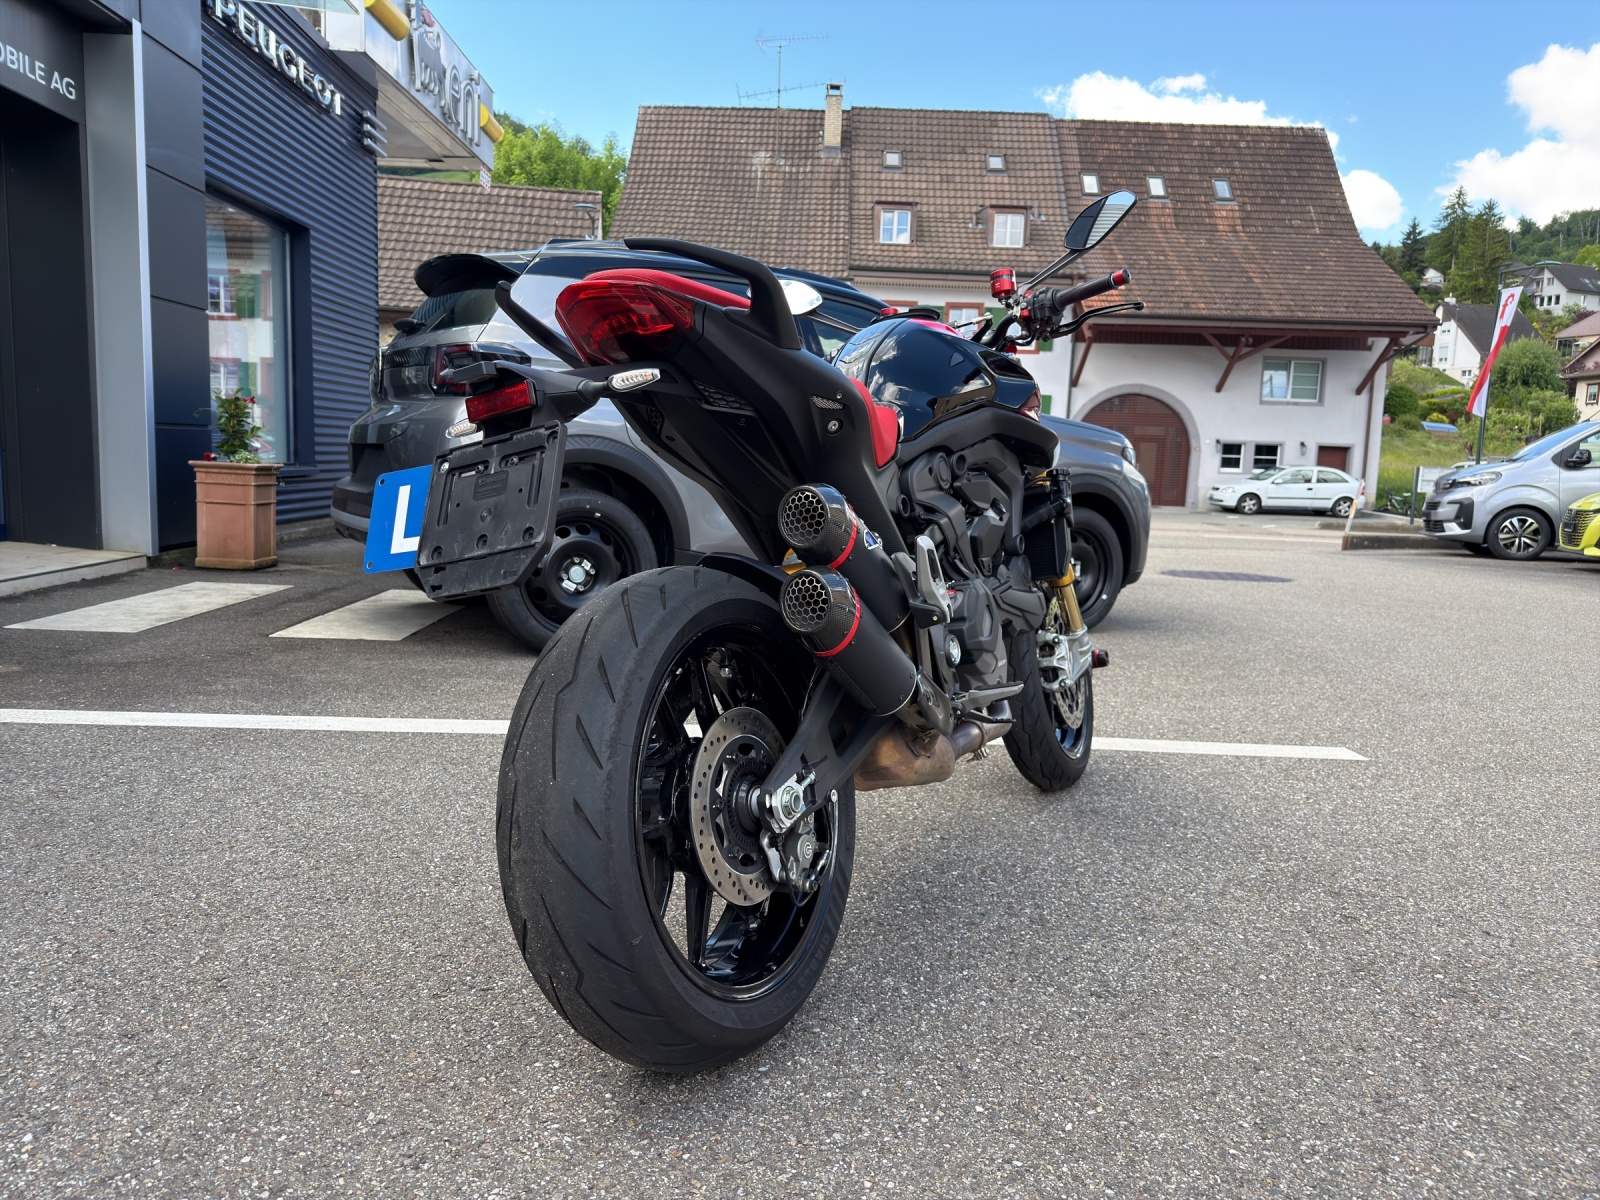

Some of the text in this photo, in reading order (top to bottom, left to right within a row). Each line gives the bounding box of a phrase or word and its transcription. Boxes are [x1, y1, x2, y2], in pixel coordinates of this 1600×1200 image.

[50, 70, 76, 100] AG
[211, 0, 345, 115] PEUGEOT
[445, 64, 480, 147] eni
[390, 484, 421, 554] L
